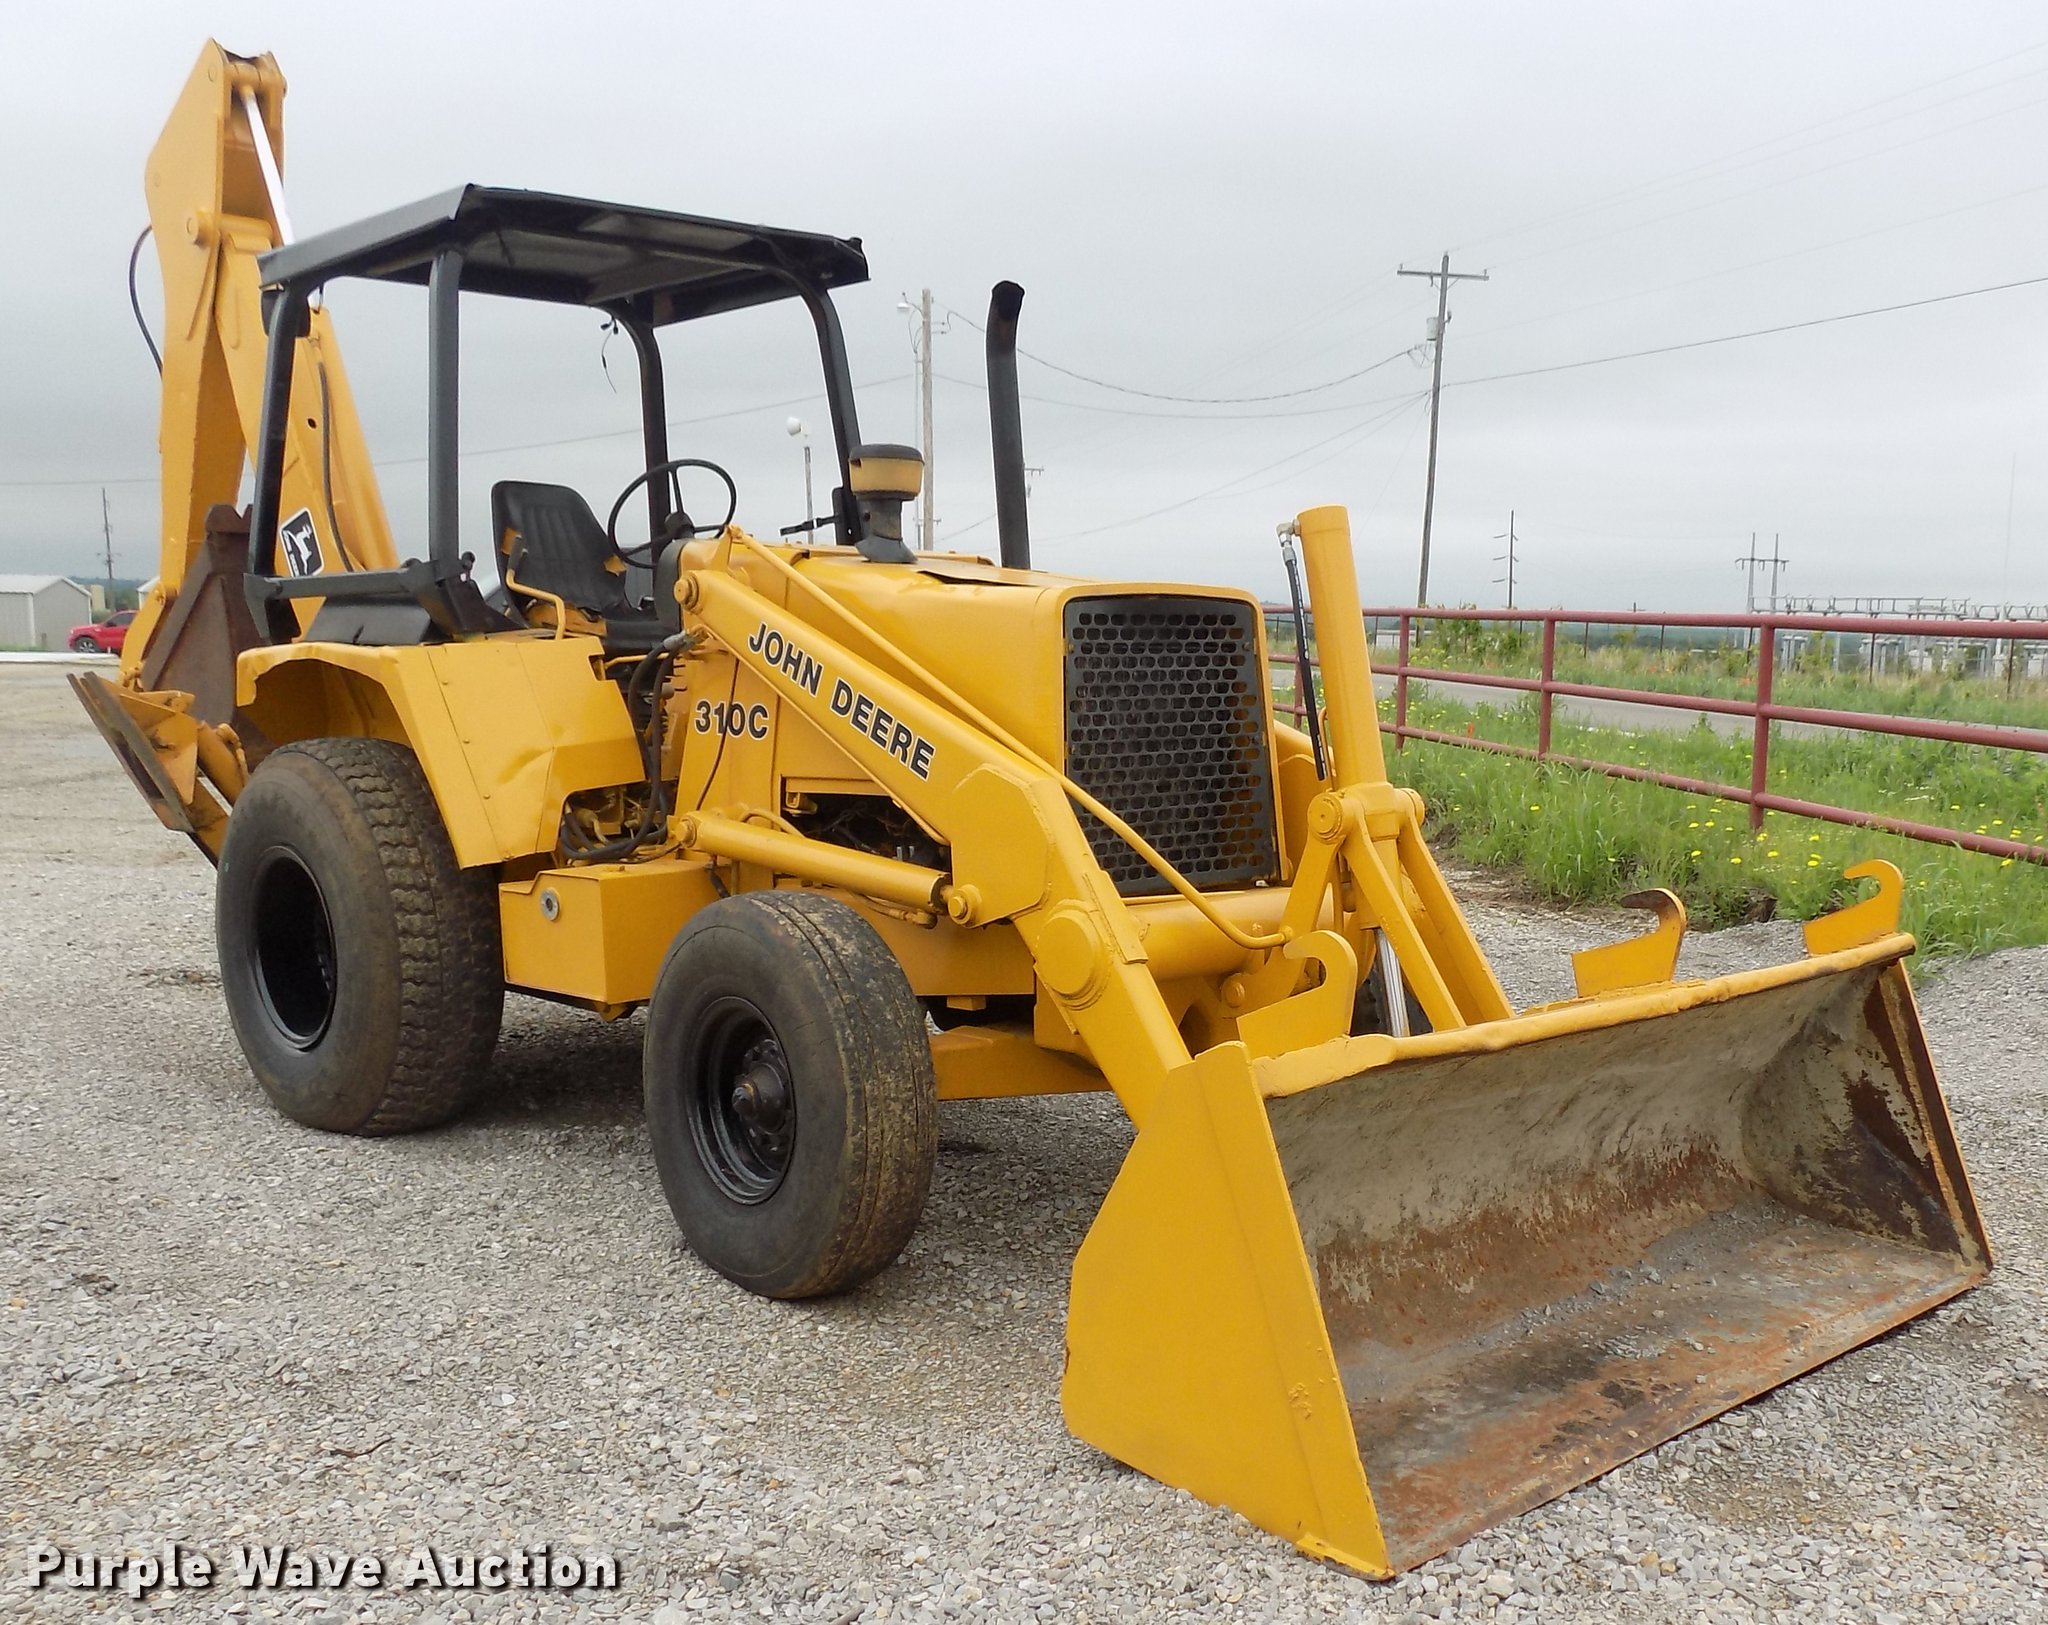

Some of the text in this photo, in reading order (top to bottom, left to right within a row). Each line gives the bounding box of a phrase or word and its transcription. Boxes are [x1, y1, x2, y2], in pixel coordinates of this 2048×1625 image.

[694, 699, 769, 740] 310C
[748, 621, 935, 781] JOHN DEERE
